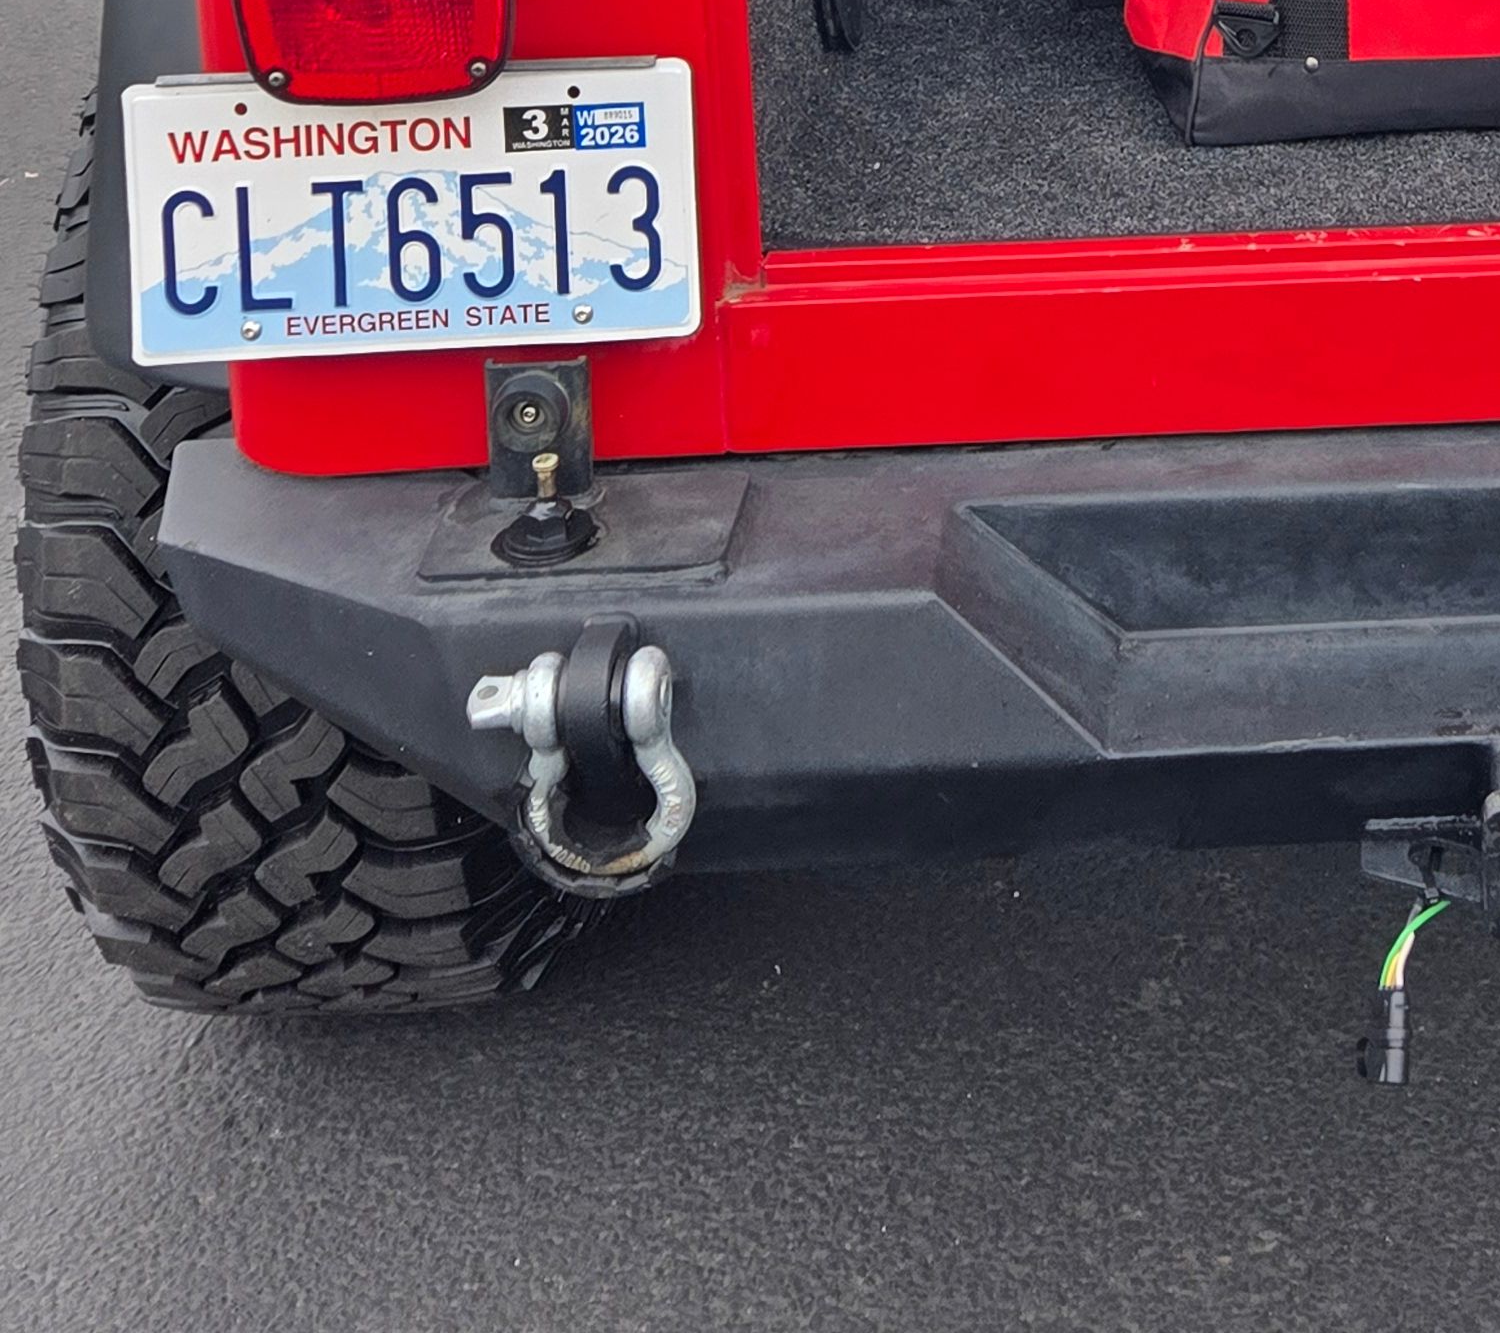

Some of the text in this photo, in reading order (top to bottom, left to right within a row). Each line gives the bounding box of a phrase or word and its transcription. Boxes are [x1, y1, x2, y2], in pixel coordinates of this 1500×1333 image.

[521, 109, 549, 141] 3
[560, 107, 570, 137] MAR
[580, 124, 640, 147] 2026
[168, 116, 473, 164] WASHINGTON
[512, 138, 571, 150] WASHINGTON
[161, 165, 662, 316] CLT6513
[285, 303, 552, 337] EVERGREEN STATE
